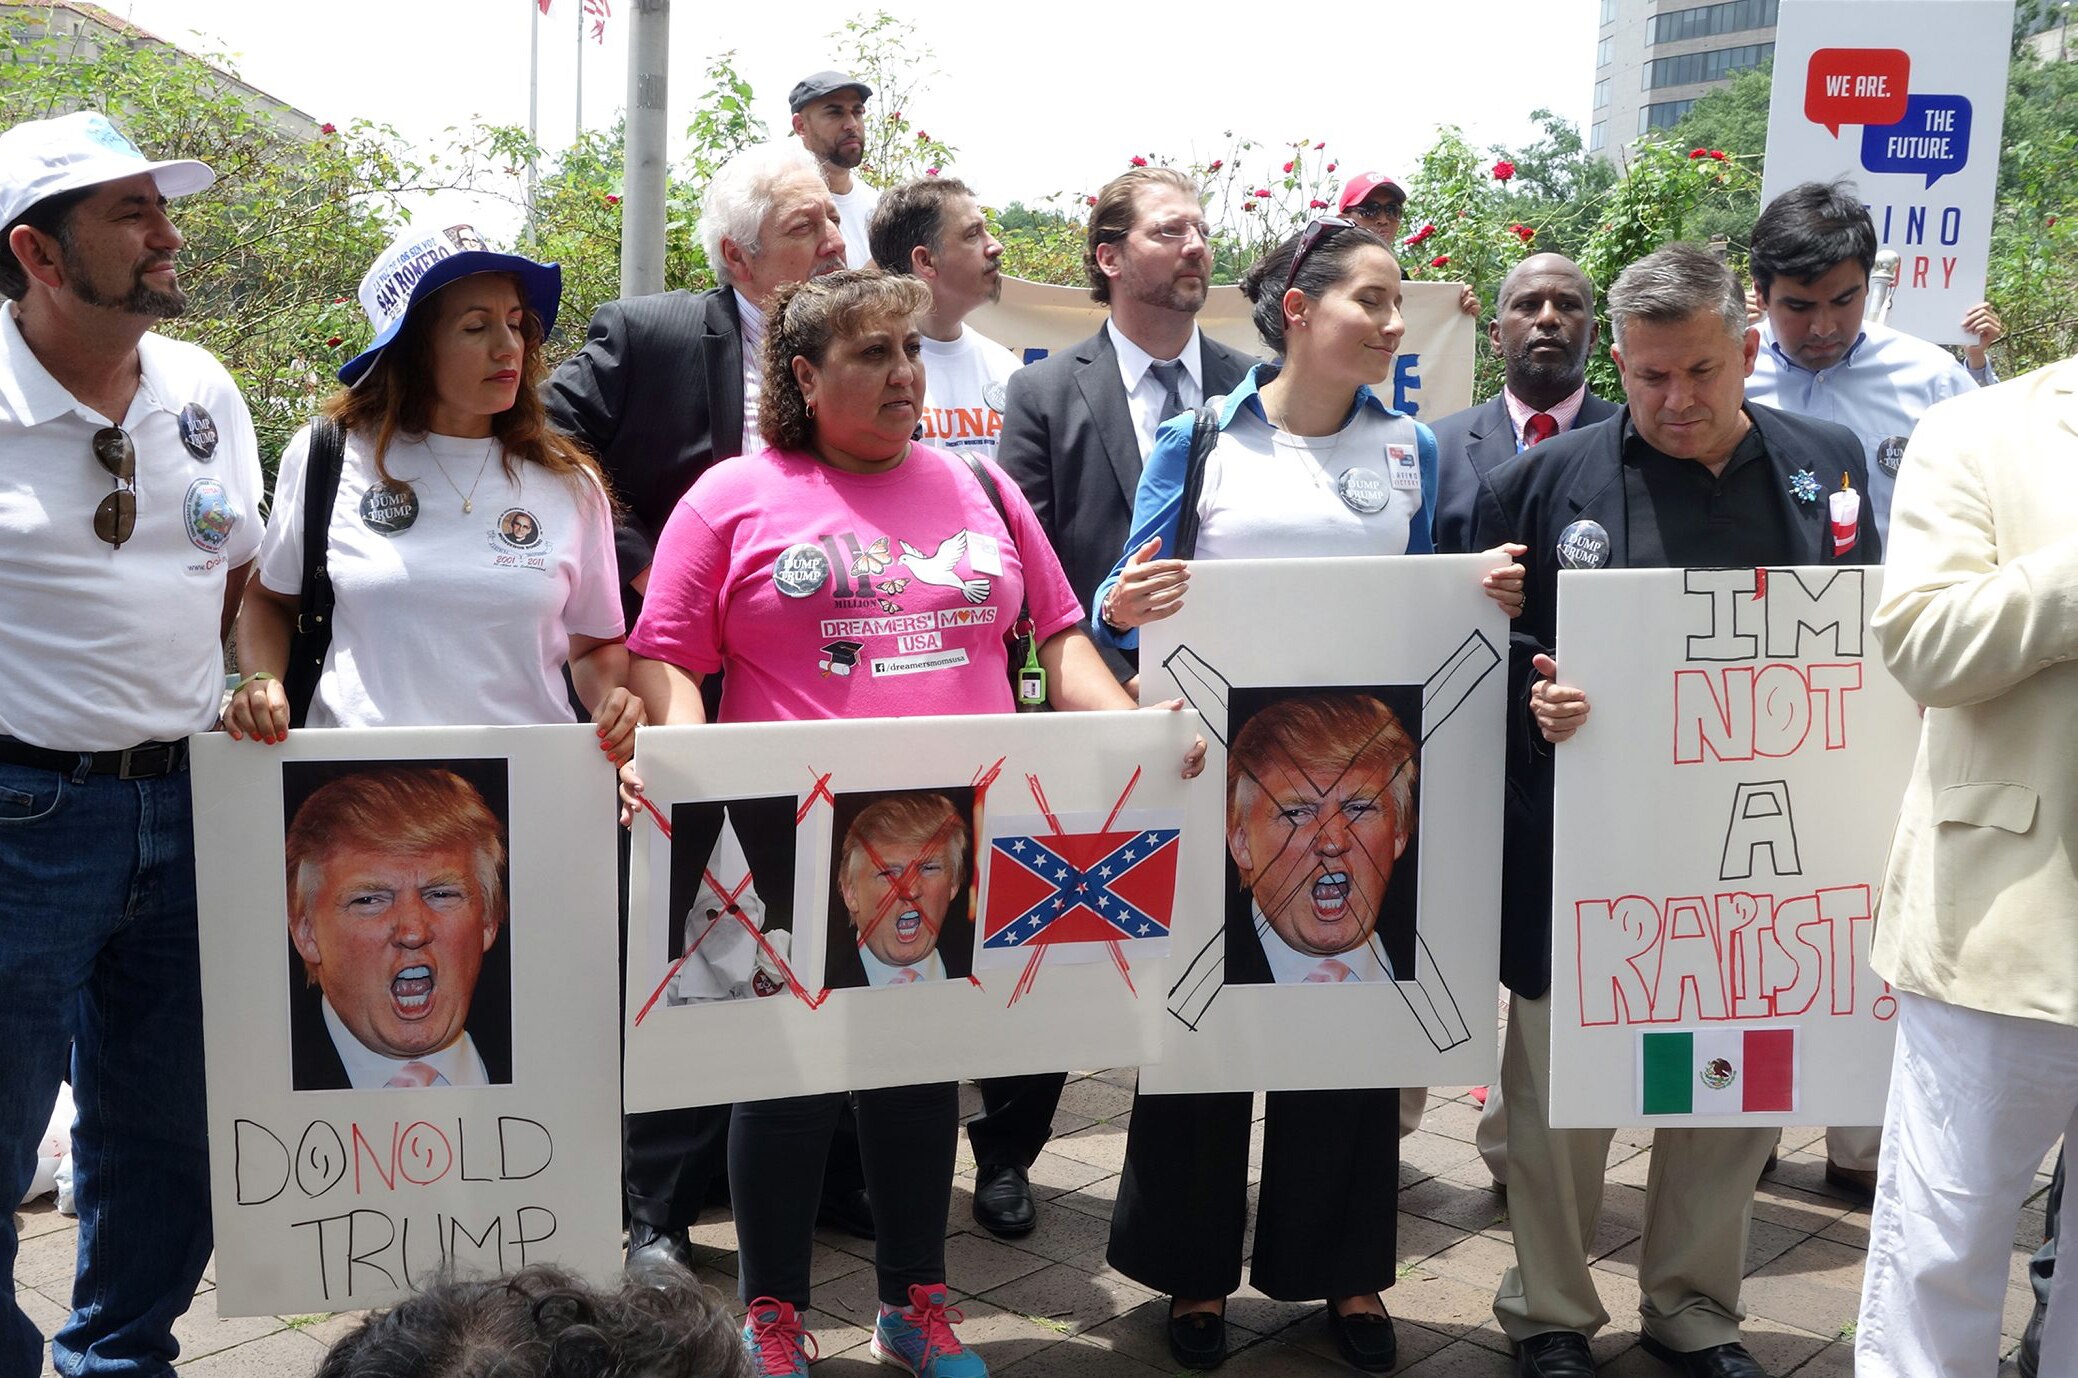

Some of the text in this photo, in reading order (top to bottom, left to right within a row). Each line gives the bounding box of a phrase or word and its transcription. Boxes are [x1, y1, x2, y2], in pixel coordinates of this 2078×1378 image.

[1826, 75, 1891, 97] WE ARE.
[1925, 110, 1956, 132] THE
[1887, 137, 1954, 159] FUTURE.
[1864, 205, 1961, 246] INO
[376, 245, 451, 316] SAN ROMERO
[187, 417, 211, 433] DUMP
[188, 431, 216, 447] TRUMP
[1886, 448, 1904, 457] DU
[1348, 479, 1379, 489] DUMP
[368, 493, 408, 509] DUMP
[1346, 489, 1384, 500] TRUMP
[367, 504, 413, 522] TRUMP
[1568, 532, 1602, 552] DUMP
[528, 557, 544, 566] 2011
[783, 557, 821, 570] DUMP
[1563, 543, 1600, 564] TRUMP
[779, 569, 821, 582] TRUMP
[835, 600, 876, 608] MILLION
[1684, 568, 1865, 661] I'M
[822, 614, 932, 637] DREAMERS'
[903, 633, 939, 650] USA
[1674, 662, 1862, 764] NOT
[1719, 780, 1802, 880] A
[234, 1116, 553, 1205] DONOLD
[291, 1206, 557, 1300] TRUMP
